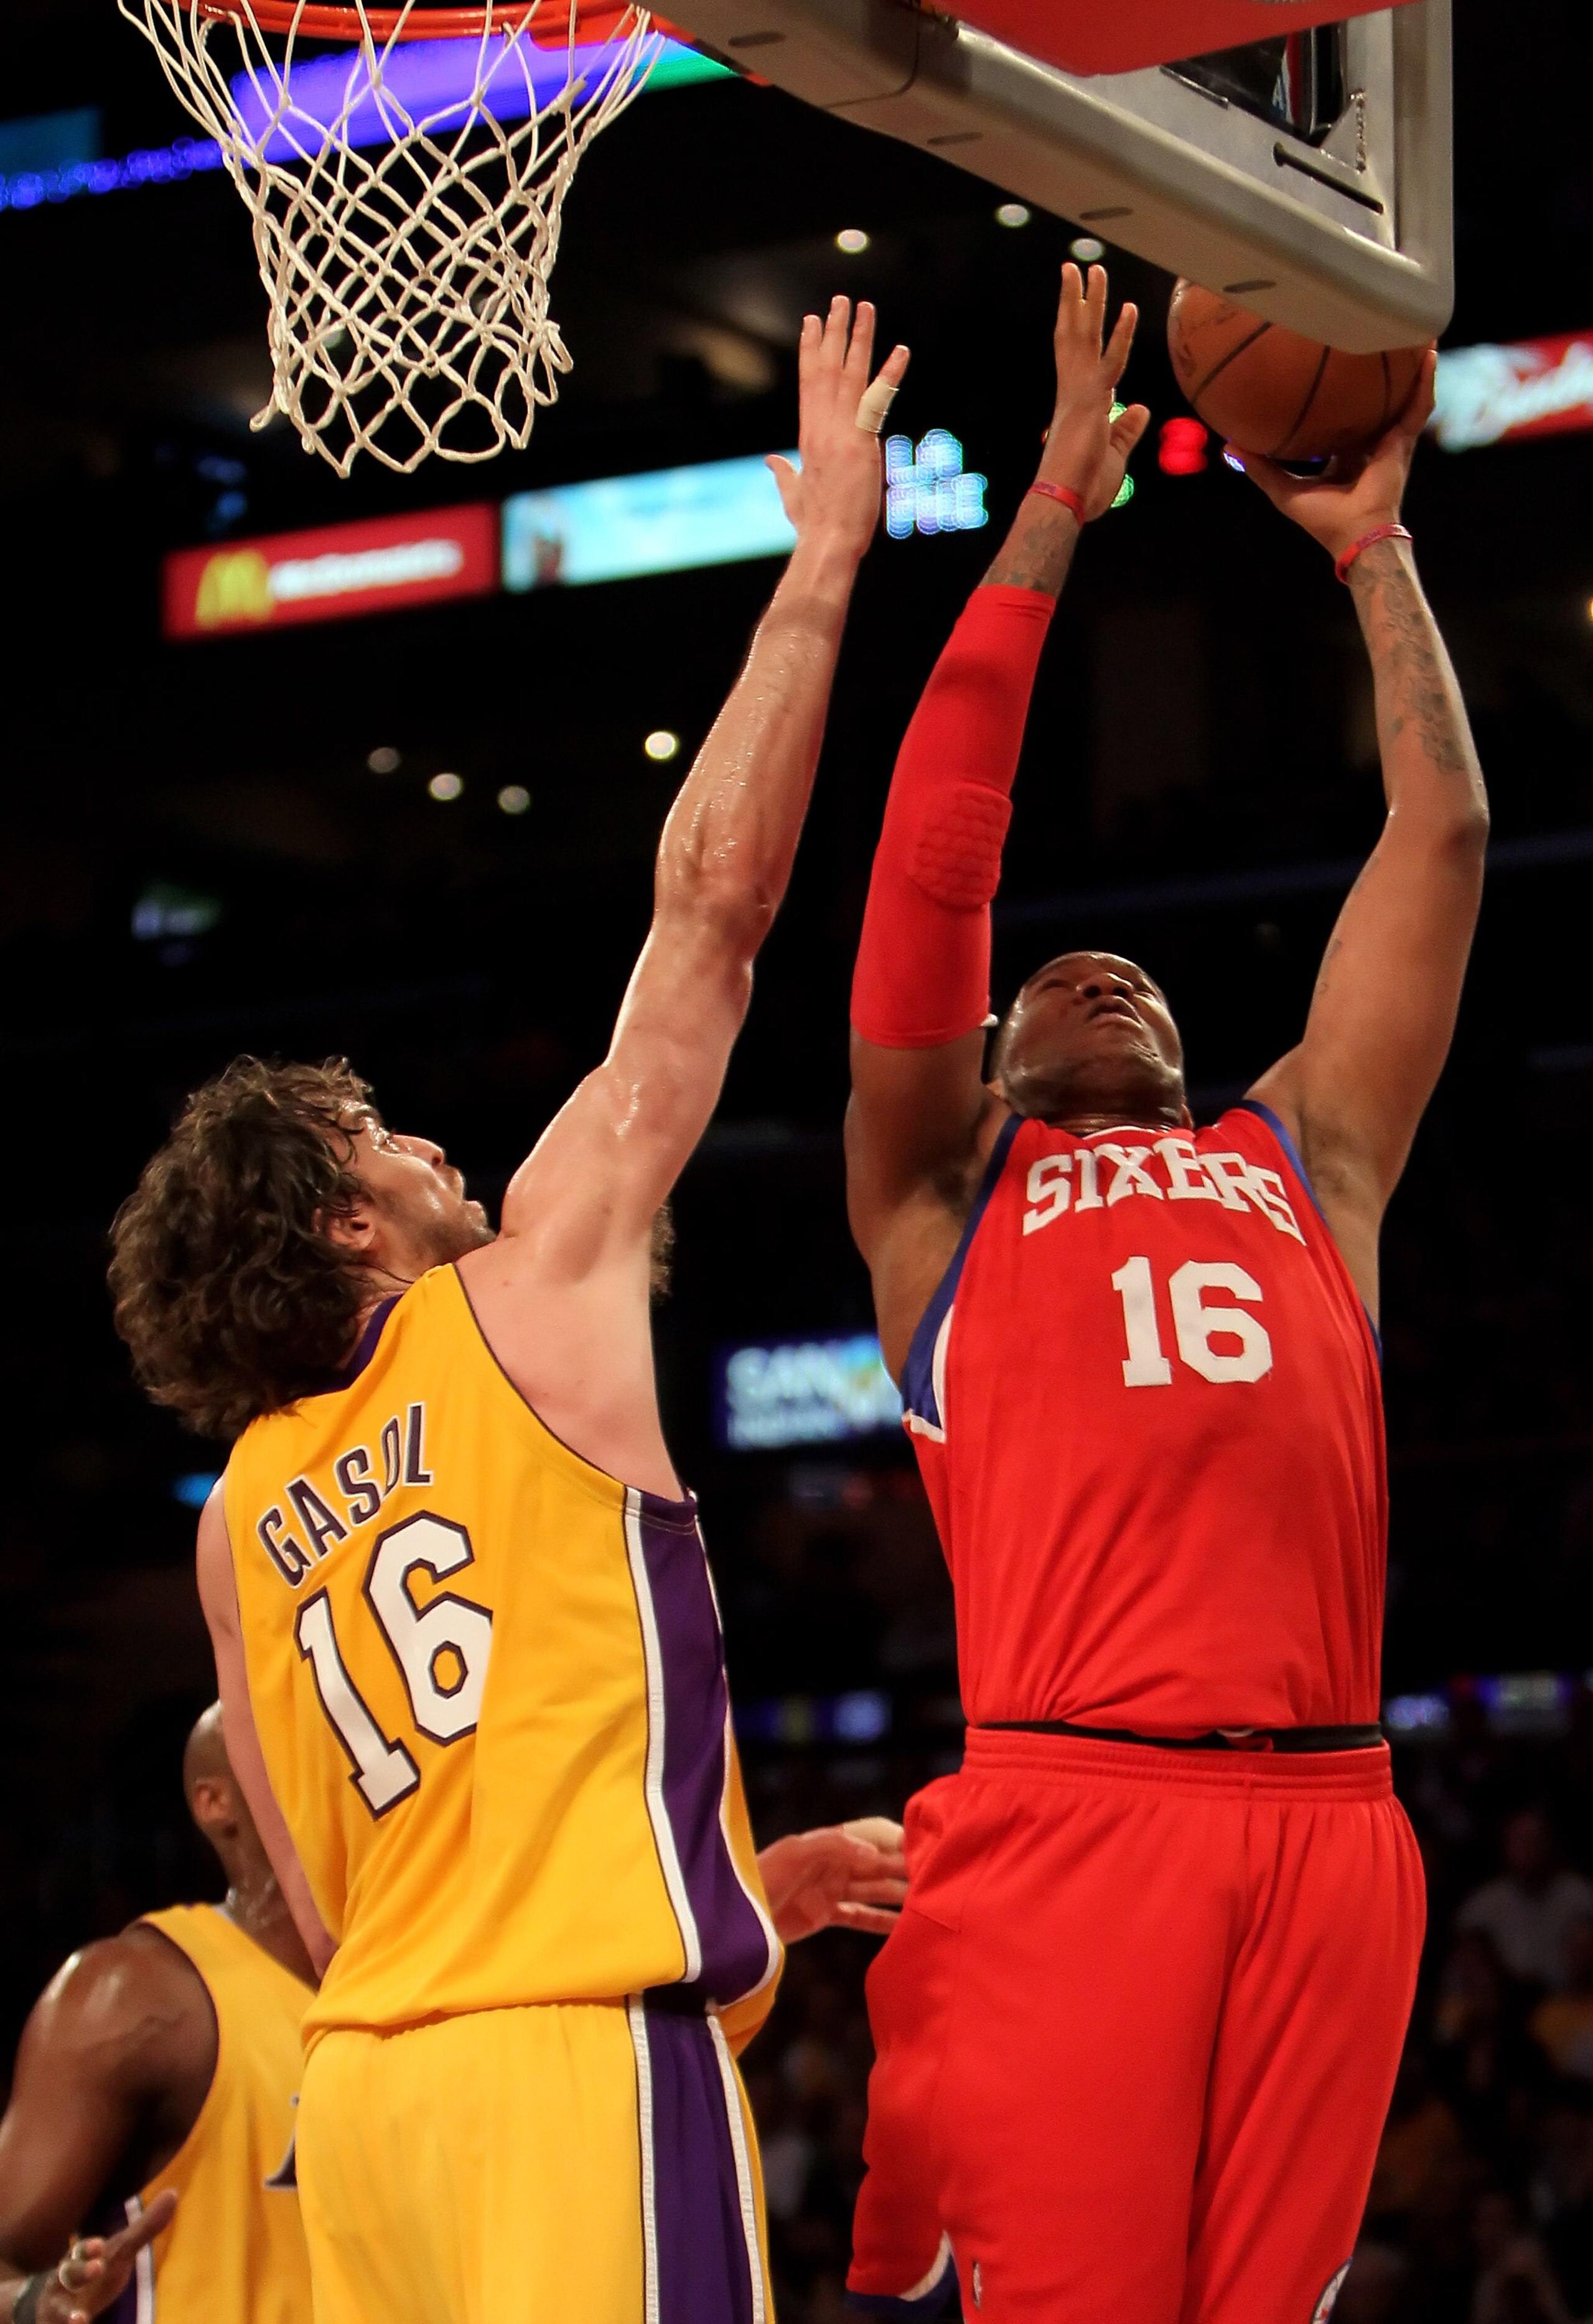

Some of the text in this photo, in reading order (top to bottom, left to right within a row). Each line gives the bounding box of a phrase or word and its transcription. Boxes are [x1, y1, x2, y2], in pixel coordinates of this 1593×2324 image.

[1022, 1138, 1307, 1246] SIXERS
[1111, 1256, 1273, 1388] 16
[256, 1401, 435, 1589] GASOL
[294, 1510, 493, 1821] 16
